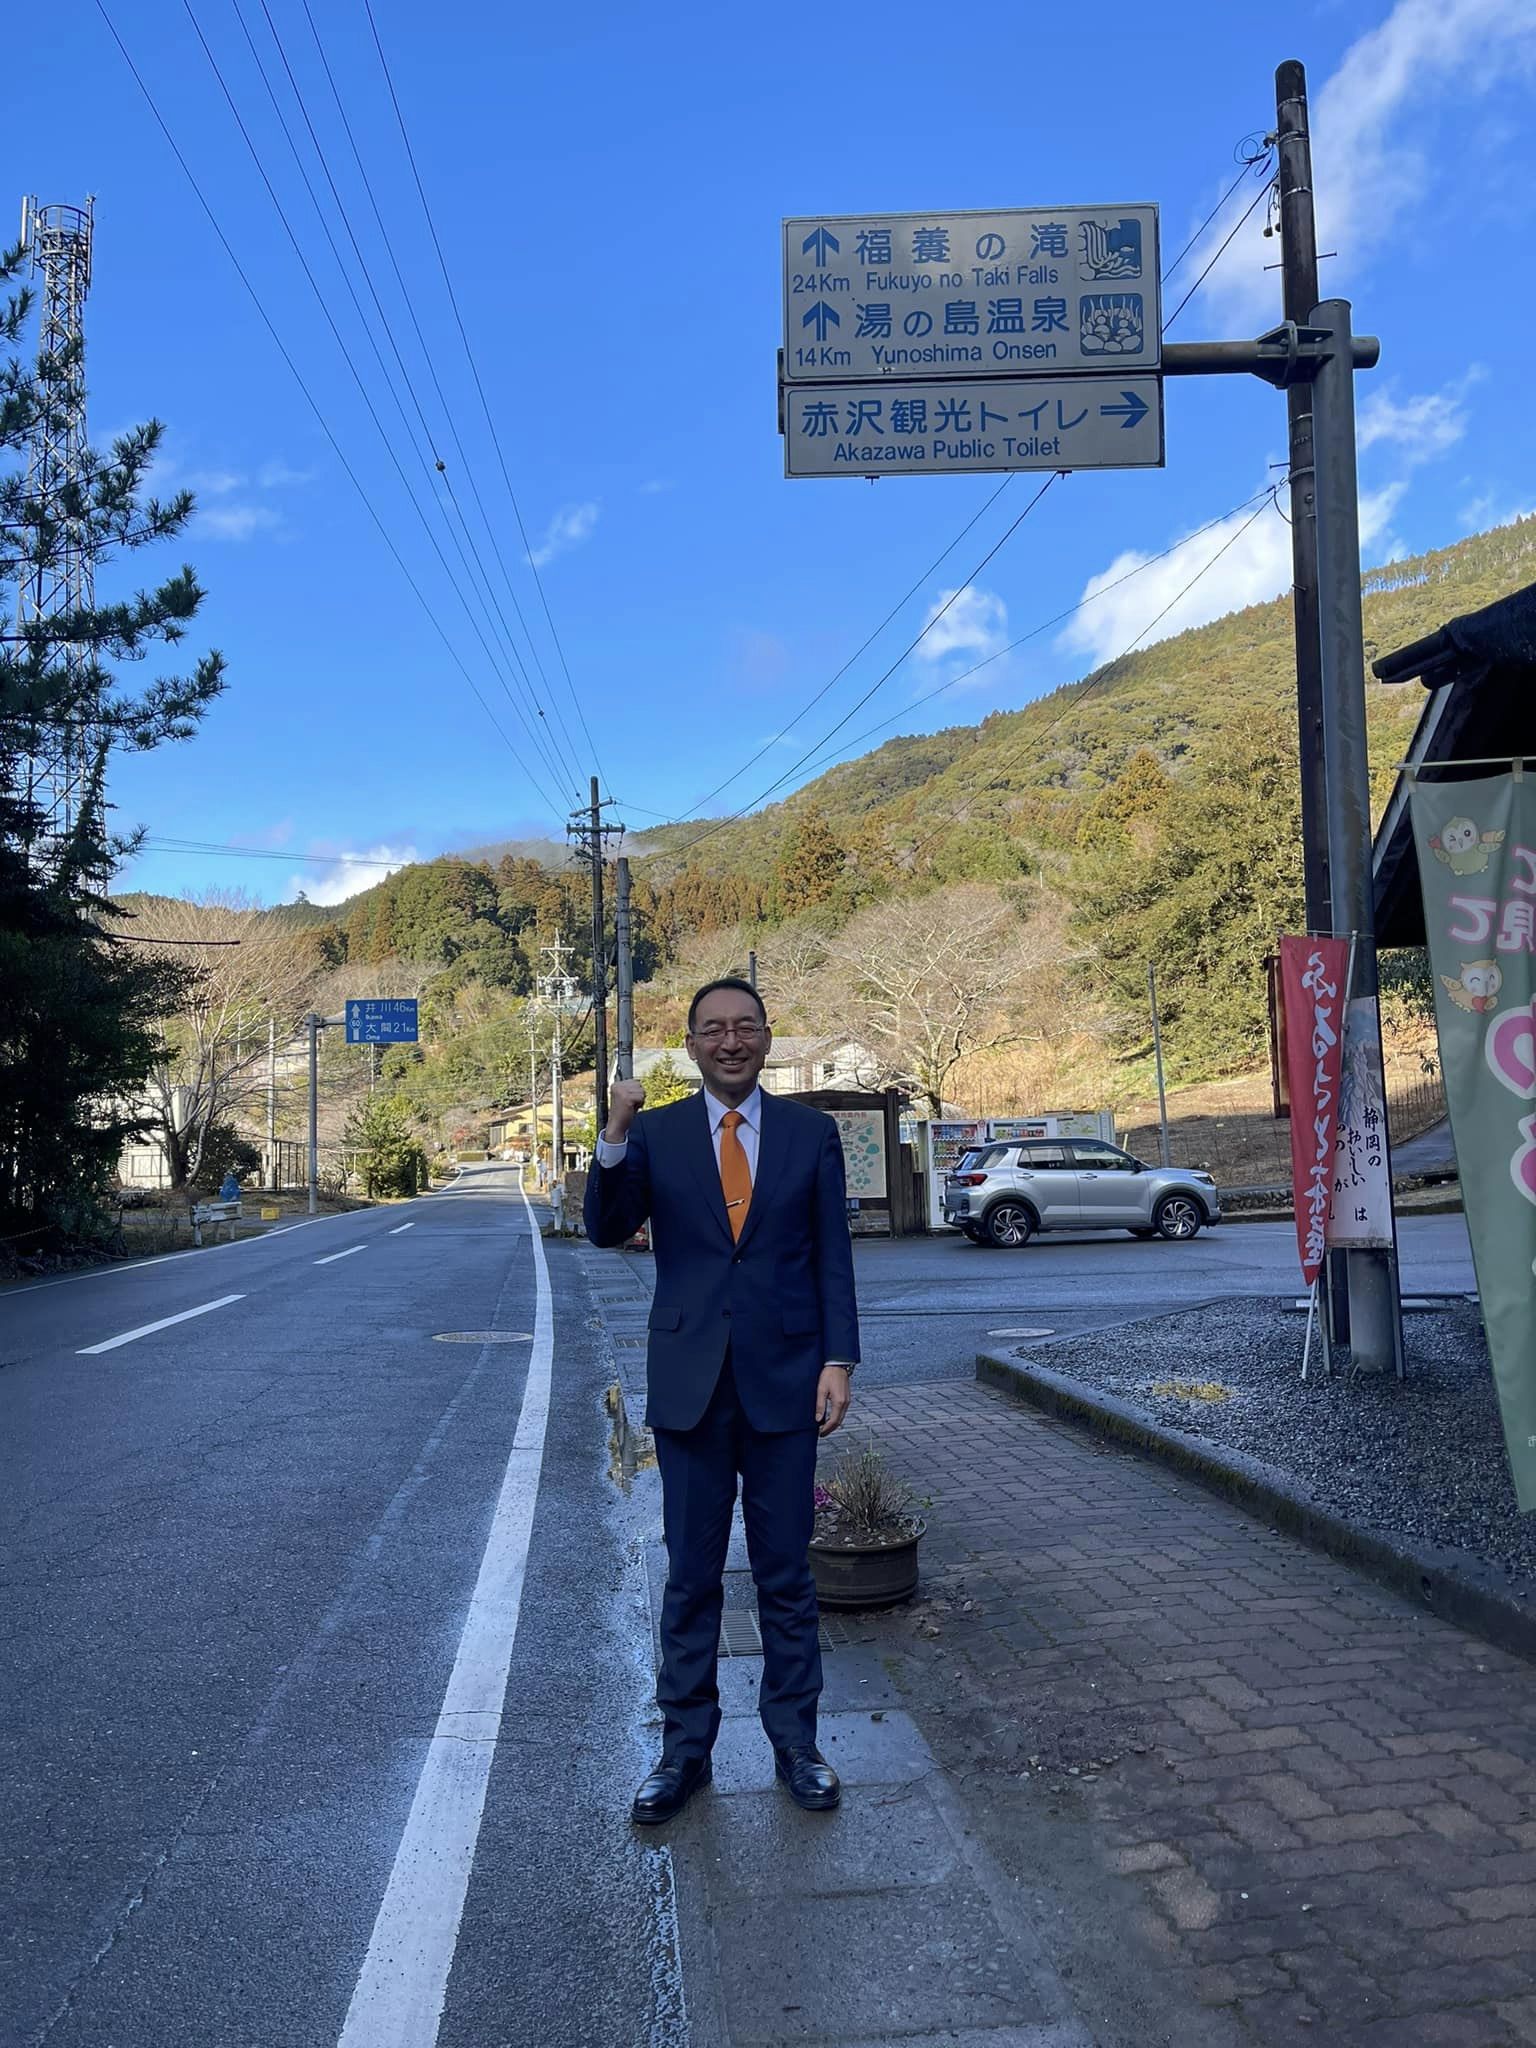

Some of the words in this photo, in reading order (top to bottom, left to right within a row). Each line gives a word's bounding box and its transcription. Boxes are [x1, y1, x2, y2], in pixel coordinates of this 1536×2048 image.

[855, 222, 1069, 266] 福養の滝
[792, 273, 850, 294] 24Km
[866, 270, 932, 293] Fukuyo
[941, 271, 962, 288] no
[972, 267, 1010, 286] Taki
[1017, 265, 1059, 284] Falls
[854, 296, 1070, 339] 湯の島温泉
[795, 347, 851, 367] 14Km
[872, 343, 982, 365] Yunoshima
[992, 340, 1057, 361] Onsen
[801, 398, 1088, 437] 赤沢観光トイレ
[833, 442, 925, 461] Akazawa
[933, 438, 995, 459] Public
[1003, 435, 1061, 456] Toilet
[365, 1002, 391, 1013] 井川
[1362, 1105, 1382, 1167] 静岡の
[1347, 1126, 1367, 1186] おいしい
